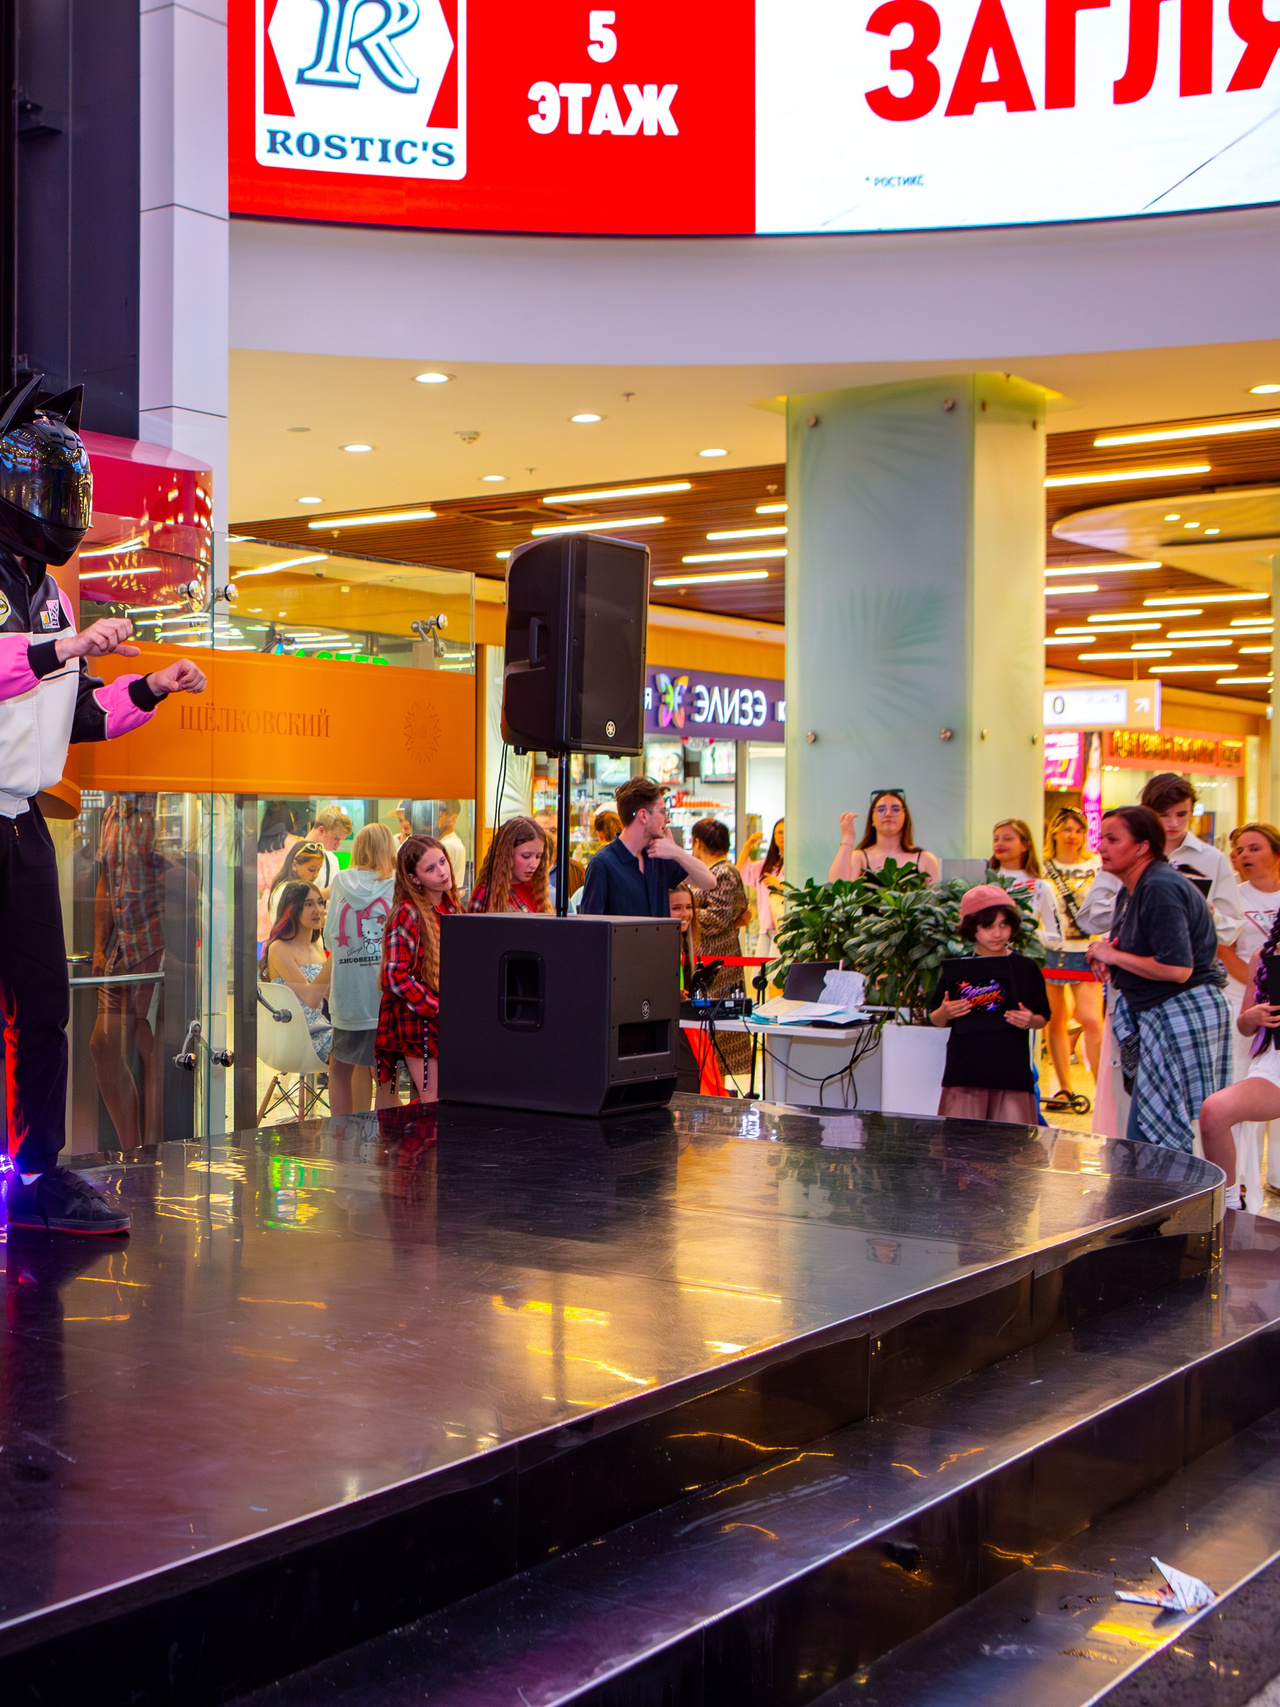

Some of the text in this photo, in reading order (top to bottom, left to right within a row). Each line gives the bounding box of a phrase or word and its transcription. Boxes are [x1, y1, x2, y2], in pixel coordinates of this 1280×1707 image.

[587, 10, 617, 63] 5
[527, 81, 680, 136] ЭТАЖ
[266, 129, 456, 167] ROSTIC'S
[180, 702, 330, 737] ЩЁЛКОВСКИЙ
[691, 684, 768, 727] ЭЛИЗЭ
